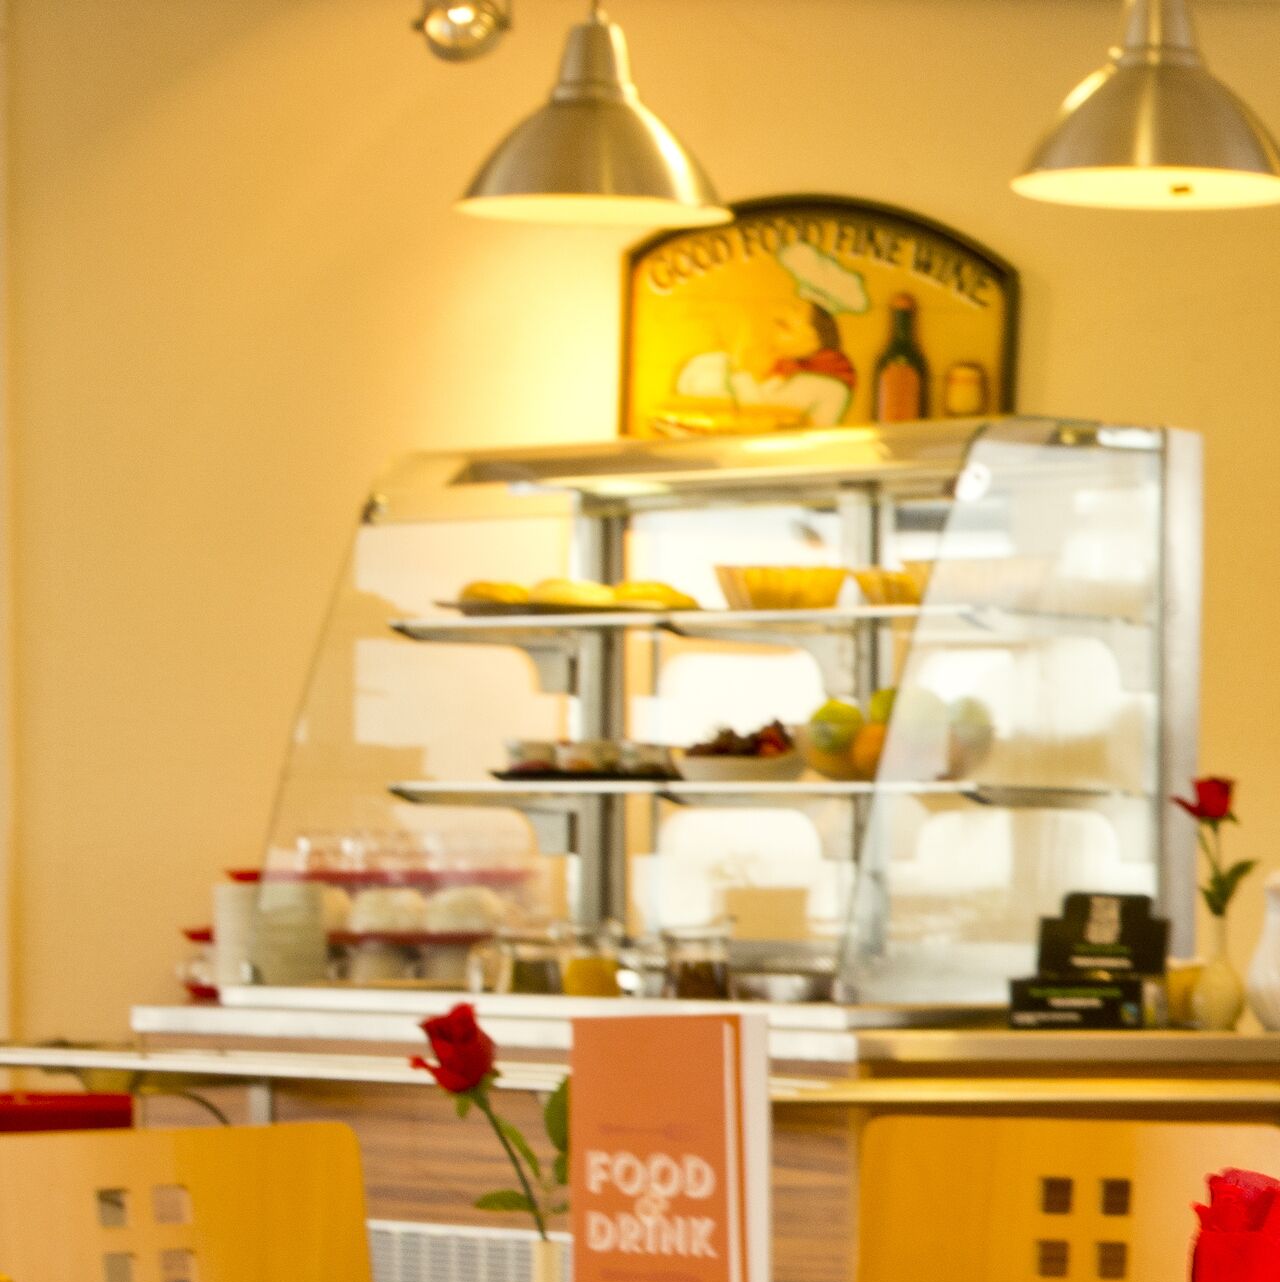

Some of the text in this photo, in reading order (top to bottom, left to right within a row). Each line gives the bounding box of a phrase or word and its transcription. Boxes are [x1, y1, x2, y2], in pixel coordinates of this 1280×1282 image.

[649, 228, 731, 295] GOOD
[585, 1149, 718, 1200] FOOD
[585, 1209, 720, 1259] DRINK
